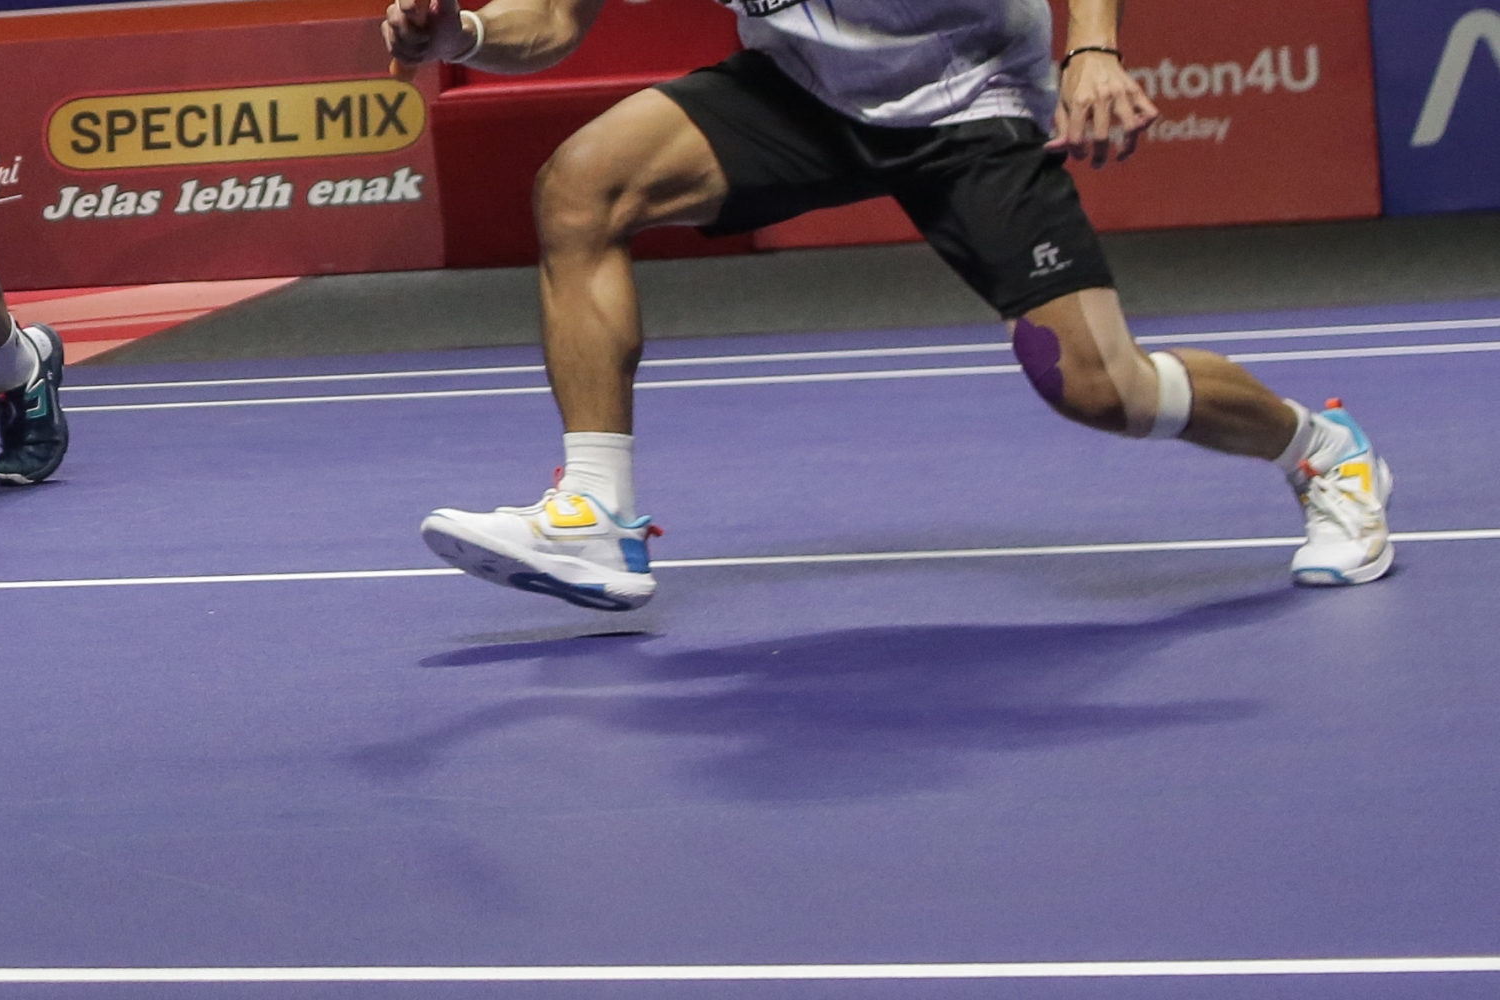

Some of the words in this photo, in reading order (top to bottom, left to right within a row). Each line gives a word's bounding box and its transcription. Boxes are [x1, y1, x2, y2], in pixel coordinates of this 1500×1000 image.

[70, 99, 298, 155] SPECIAL
[315, 92, 408, 140] MIX
[43, 184, 162, 221] Jelas
[174, 174, 292, 213] lebih
[306, 167, 424, 206] enak
